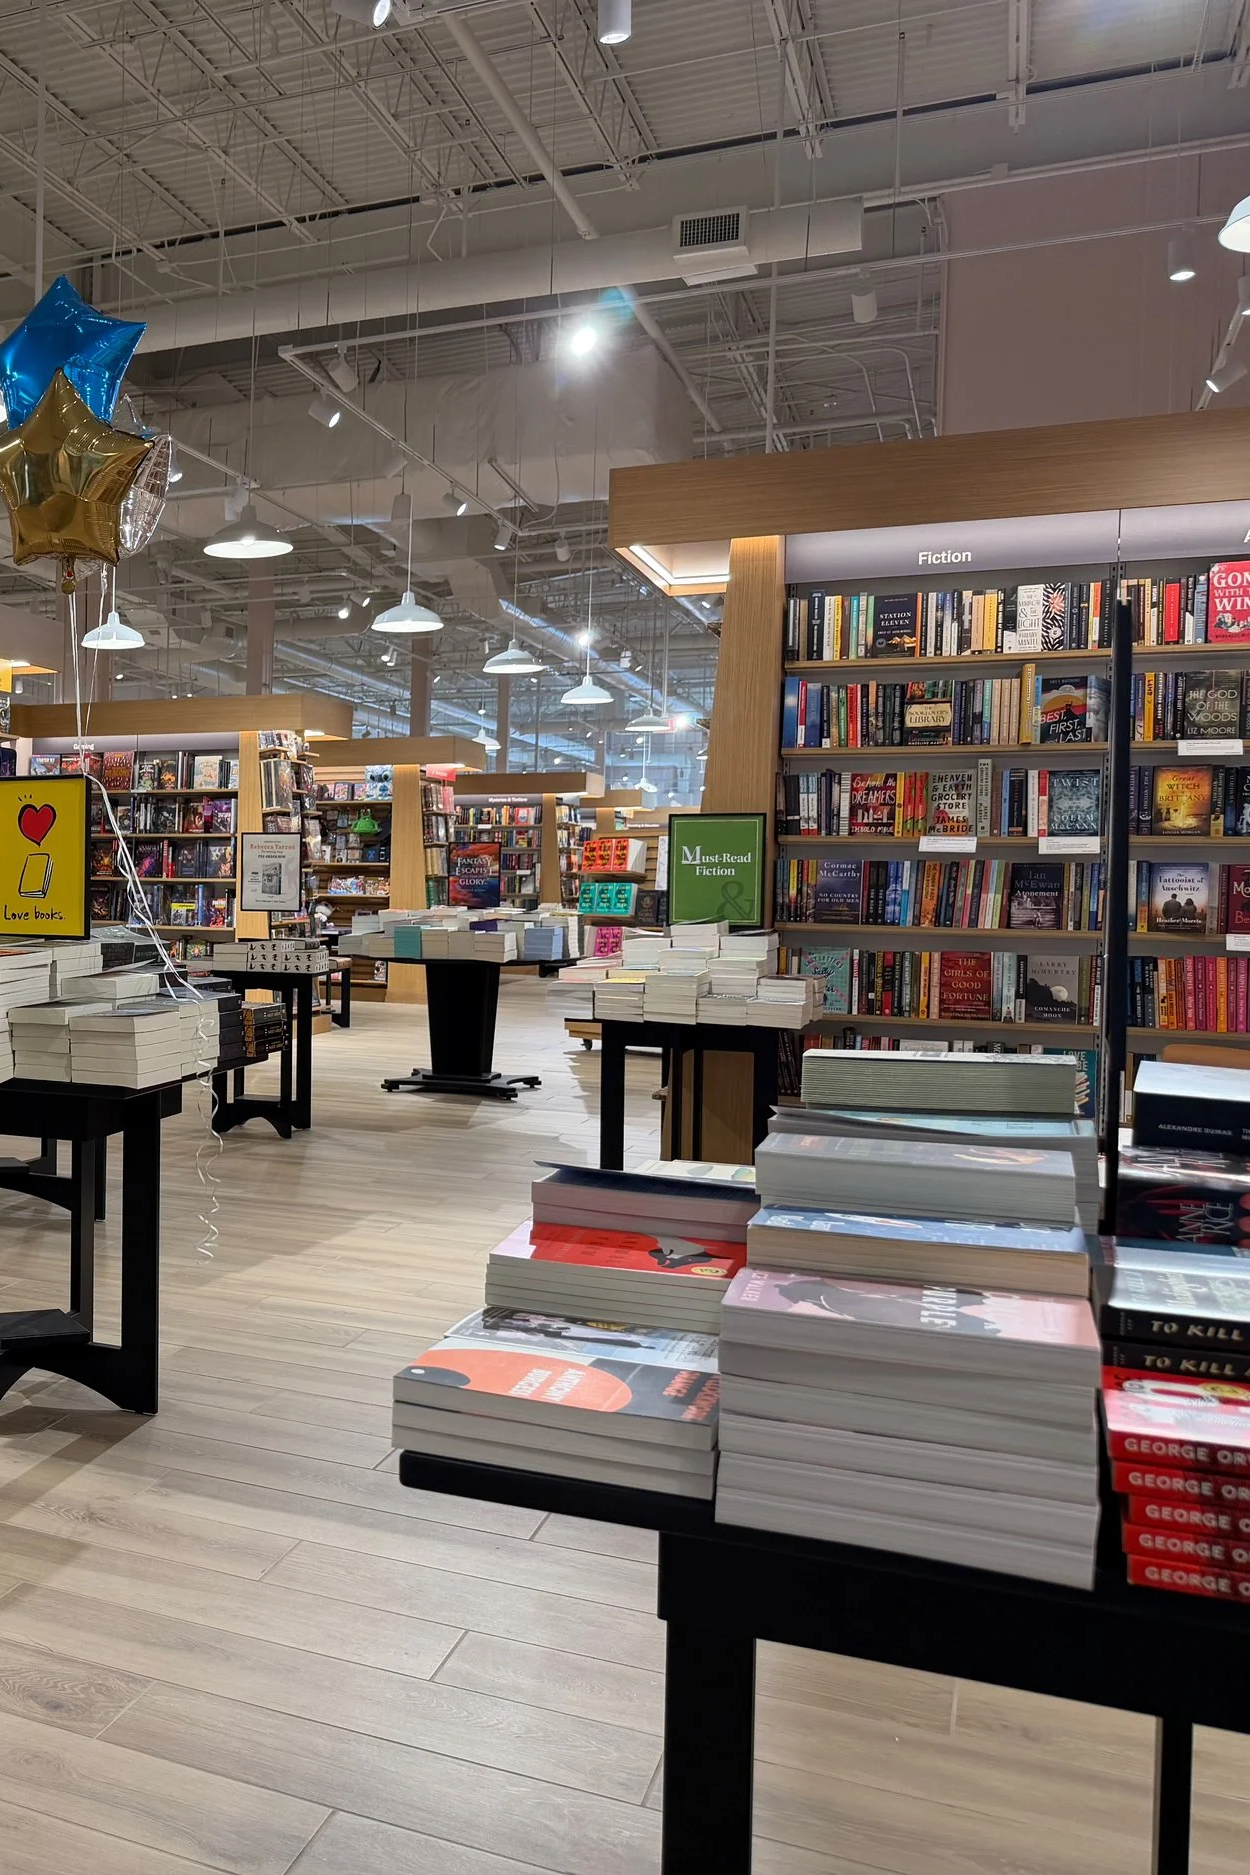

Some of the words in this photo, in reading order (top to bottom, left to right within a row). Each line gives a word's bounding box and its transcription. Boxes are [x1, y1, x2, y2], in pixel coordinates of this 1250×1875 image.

[918, 550, 972, 565] Fiction
[1214, 588, 1243, 597] WITH
[879, 611, 912, 619] STATION
[1018, 608, 1028, 618] &
[881, 619, 910, 627] ELEVEN
[1018, 618, 1040, 629] LIGHT
[1189, 690, 1205, 699] THE
[1207, 689, 1238, 699] GOD
[1197, 701, 1211, 710] OF
[1213, 701, 1230, 709] THE
[909, 714, 946, 724] LIBRARY
[1040, 709, 1067, 724] BEST,
[1187, 712, 1238, 721] WOODS
[1050, 719, 1080, 734] FIRST,
[1187, 727, 1198, 735] LIZ
[1200, 726, 1236, 734] MOORE
[1059, 729, 1087, 743] LAST
[73, 743, 95, 751] Gaming
[852, 776, 884, 788] Behold
[937, 773, 972, 783] HEAVEN
[1052, 777, 1099, 787] TWIST
[932, 784, 939, 793] &
[943, 783, 972, 792] EARTH
[851, 790, 896, 804] DREAMERS
[931, 792, 972, 801] GROCERY
[936, 802, 967, 810] STORE
[935, 815, 966, 824] JAMES
[1053, 814, 1094, 822] COLUM
[928, 824, 974, 833] McBRIDE
[1051, 822, 1097, 830] McCANN
[681, 845, 752, 865] Must-Read
[457, 857, 493, 866] FANTASY
[824, 861, 857, 869] Cormac
[695, 865, 735, 876] Fiction
[819, 870, 862, 879] McCarthy
[1029, 871, 1046, 879] Ian
[1014, 880, 1060, 889] McEwan
[1158, 876, 1195, 884] Tattooist
[1161, 884, 1200, 892] Auschwitz
[4, 904, 29, 920] Love
[34, 905, 66, 920] books.
[957, 958, 977, 966] THE
[944, 969, 973, 977] GIRLS
[976, 970, 990, 978] OF
[951, 981, 982, 989] GOOD
[943, 993, 989, 1001] FORTUNE
[1158, 1123, 1203, 1133] ALEXANDRE
[1203, 1127, 1233, 1136] DUMAS
[1175, 1203, 1205, 1244] ANNE
[1200, 1202, 1234, 1236] RICE
[920, 1284, 957, 1329] PURPLE
[1151, 1320, 1179, 1334] TO
[1187, 1324, 1244, 1341] KILL
[1144, 1355, 1172, 1368] TO
[1179, 1358, 1235, 1376] KILL
[1124, 1437, 1210, 1460] GEORGE
[1128, 1471, 1214, 1496] GEORGE
[1145, 1504, 1232, 1530] GEORGE
[1138, 1533, 1225, 1560] GEORGE
[1144, 1566, 1232, 1593] GEORGE
